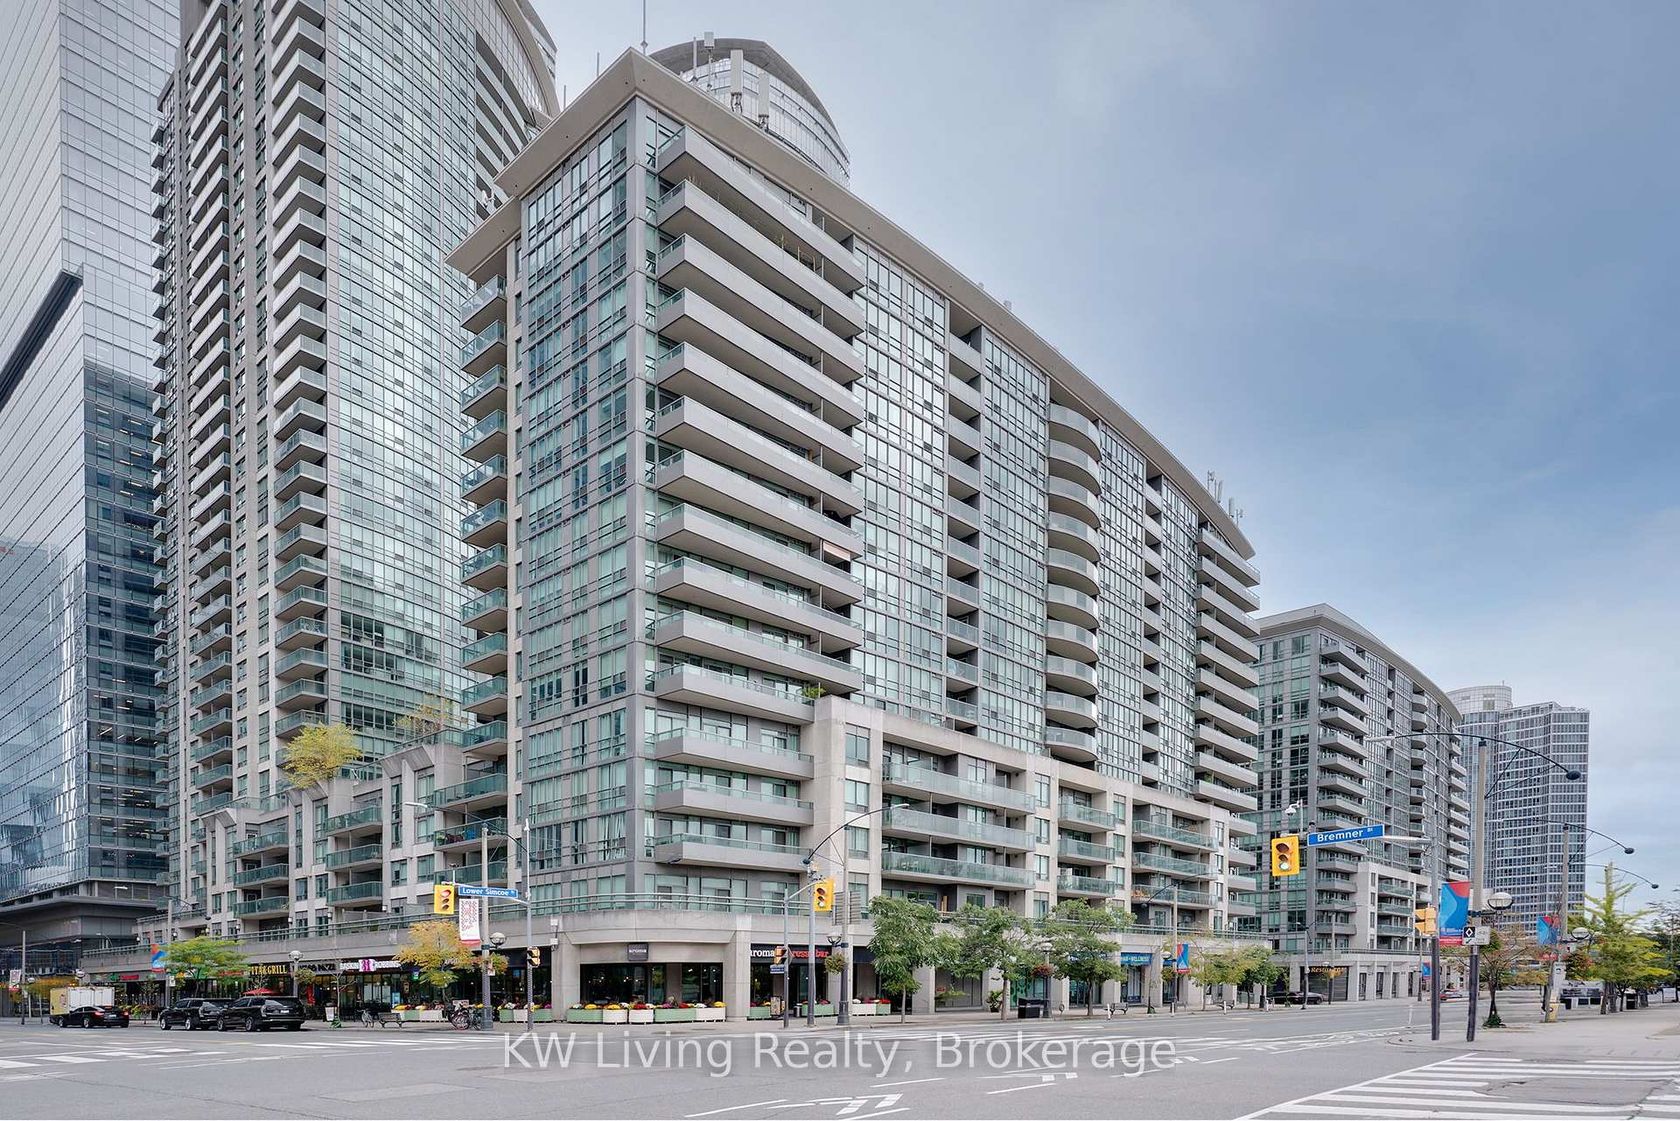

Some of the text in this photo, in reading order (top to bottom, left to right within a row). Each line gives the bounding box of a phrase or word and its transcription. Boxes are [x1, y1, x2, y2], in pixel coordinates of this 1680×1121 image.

[1317, 829, 1363, 842] Bremner
[462, 887, 483, 895] Lower
[485, 888, 509, 896] Simcoe
